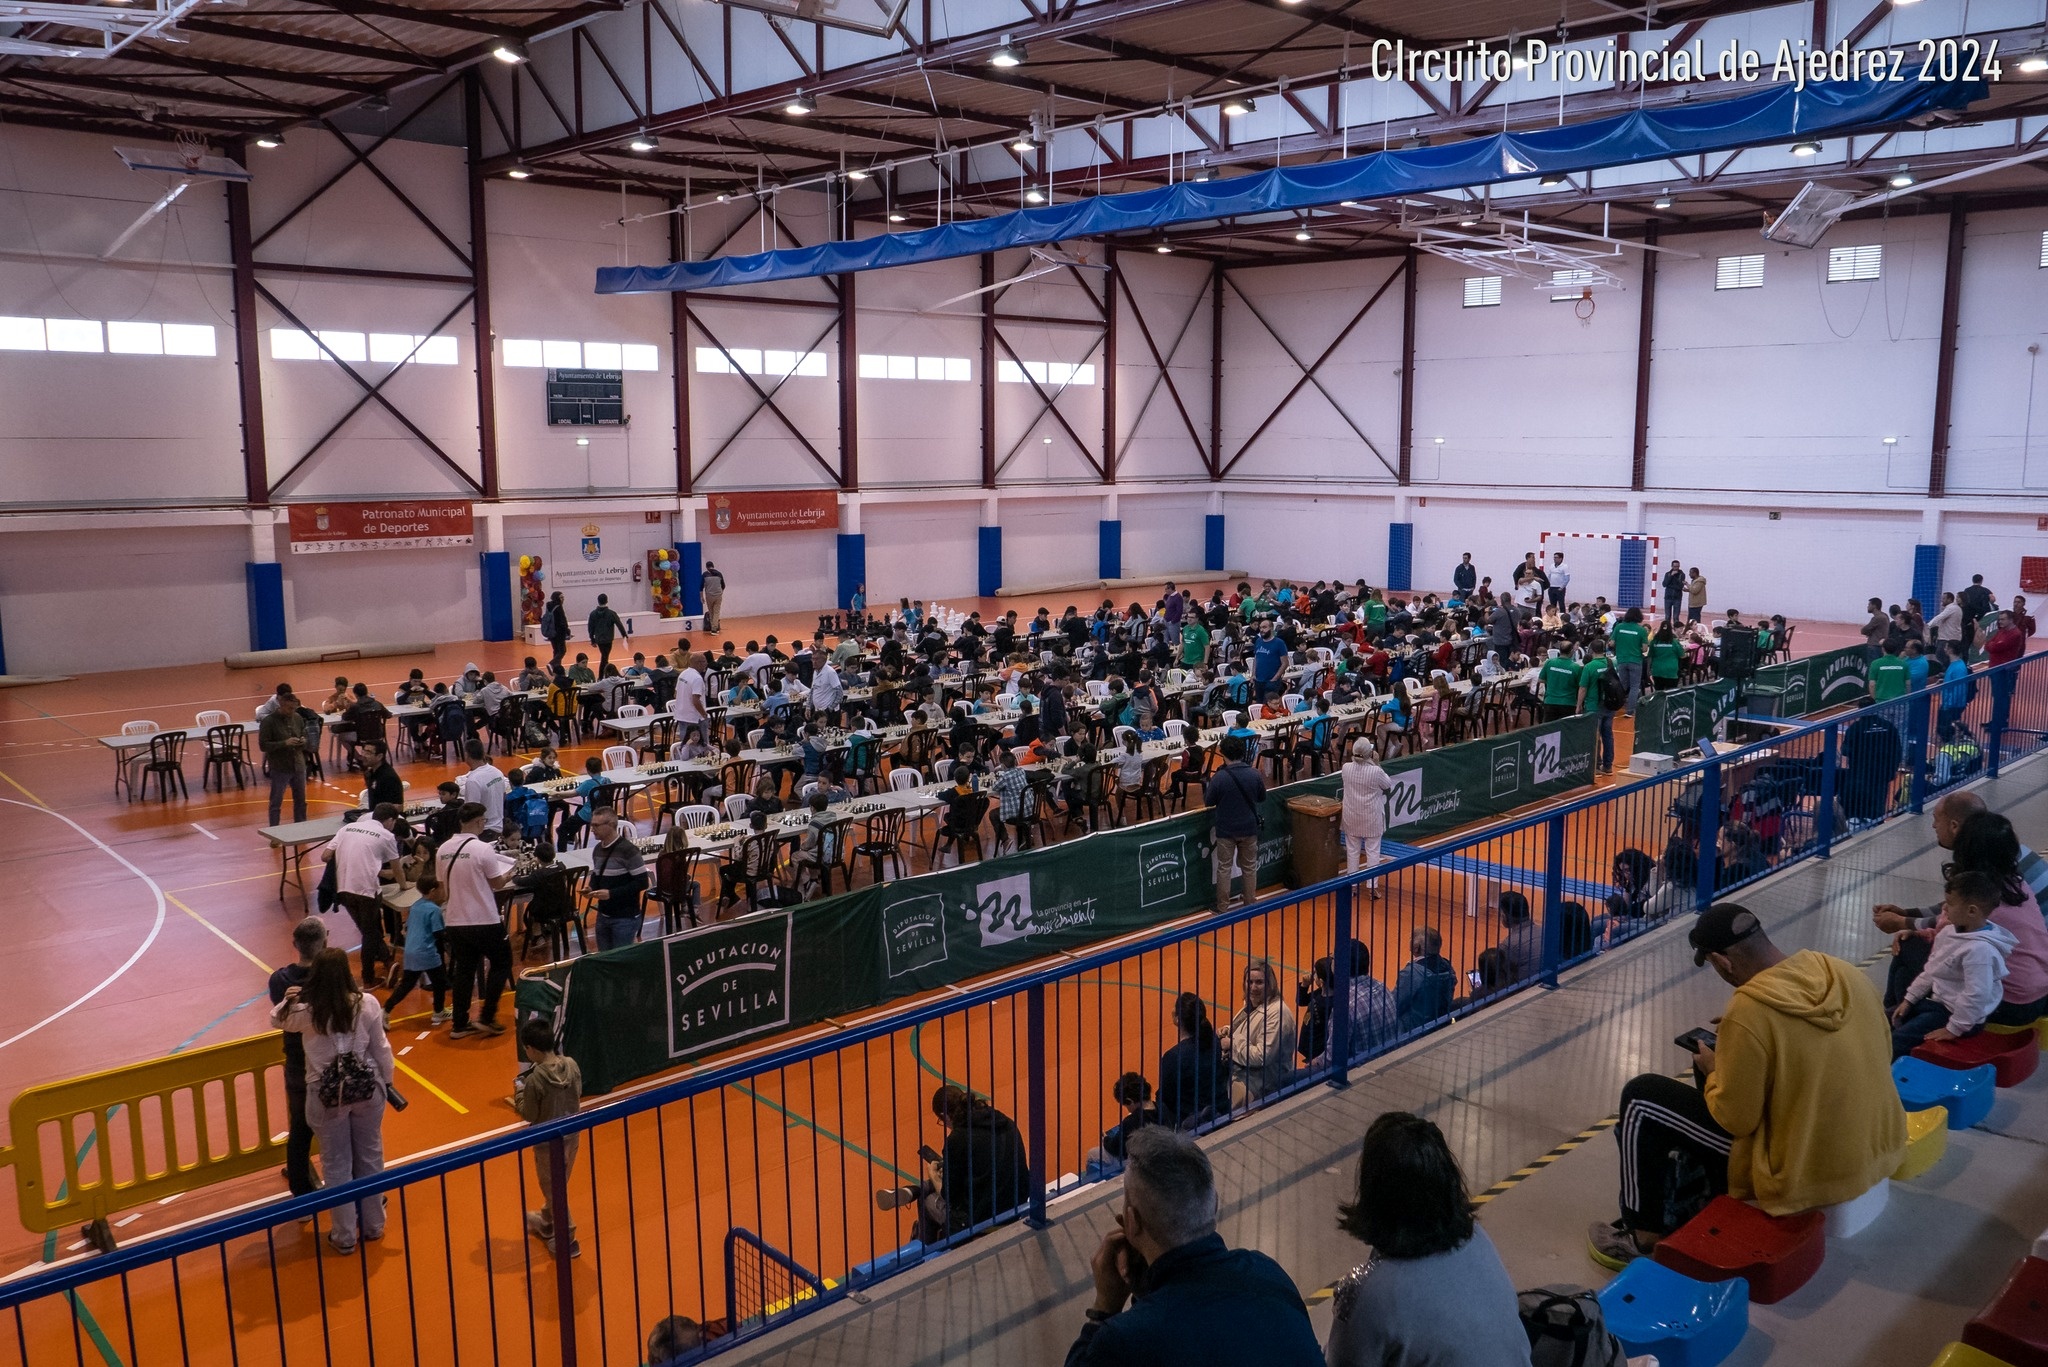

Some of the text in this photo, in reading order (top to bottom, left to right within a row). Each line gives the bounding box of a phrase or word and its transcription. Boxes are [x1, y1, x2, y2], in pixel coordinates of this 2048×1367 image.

[558, 372, 594, 381] Ayuntamiento
[603, 371, 622, 381] Lebrija
[362, 506, 466, 520] Patronato Municipal
[736, 507, 826, 523] Ayuntamiento de Lebrija
[363, 522, 430, 535] de Deportes
[555, 569, 597, 579] Ayuntamiento
[606, 566, 629, 576] Lebrija
[626, 618, 634, 635] 1
[685, 620, 692, 631] 3
[1820, 655, 1868, 690] DIPUTACION
[345, 827, 381, 839] MONITOR
[1145, 852, 1179, 869] DIPUTACION
[1147, 872, 1180, 887] SEVILLA
[1036, 900, 1082, 918] La provincia en
[892, 913, 937, 935] DIPUTACION
[896, 935, 937, 955] SEVILLA
[676, 942, 782, 986] DIPUTACION
[722, 979, 738, 993] DE
[681, 989, 778, 1032] SEVILLA
